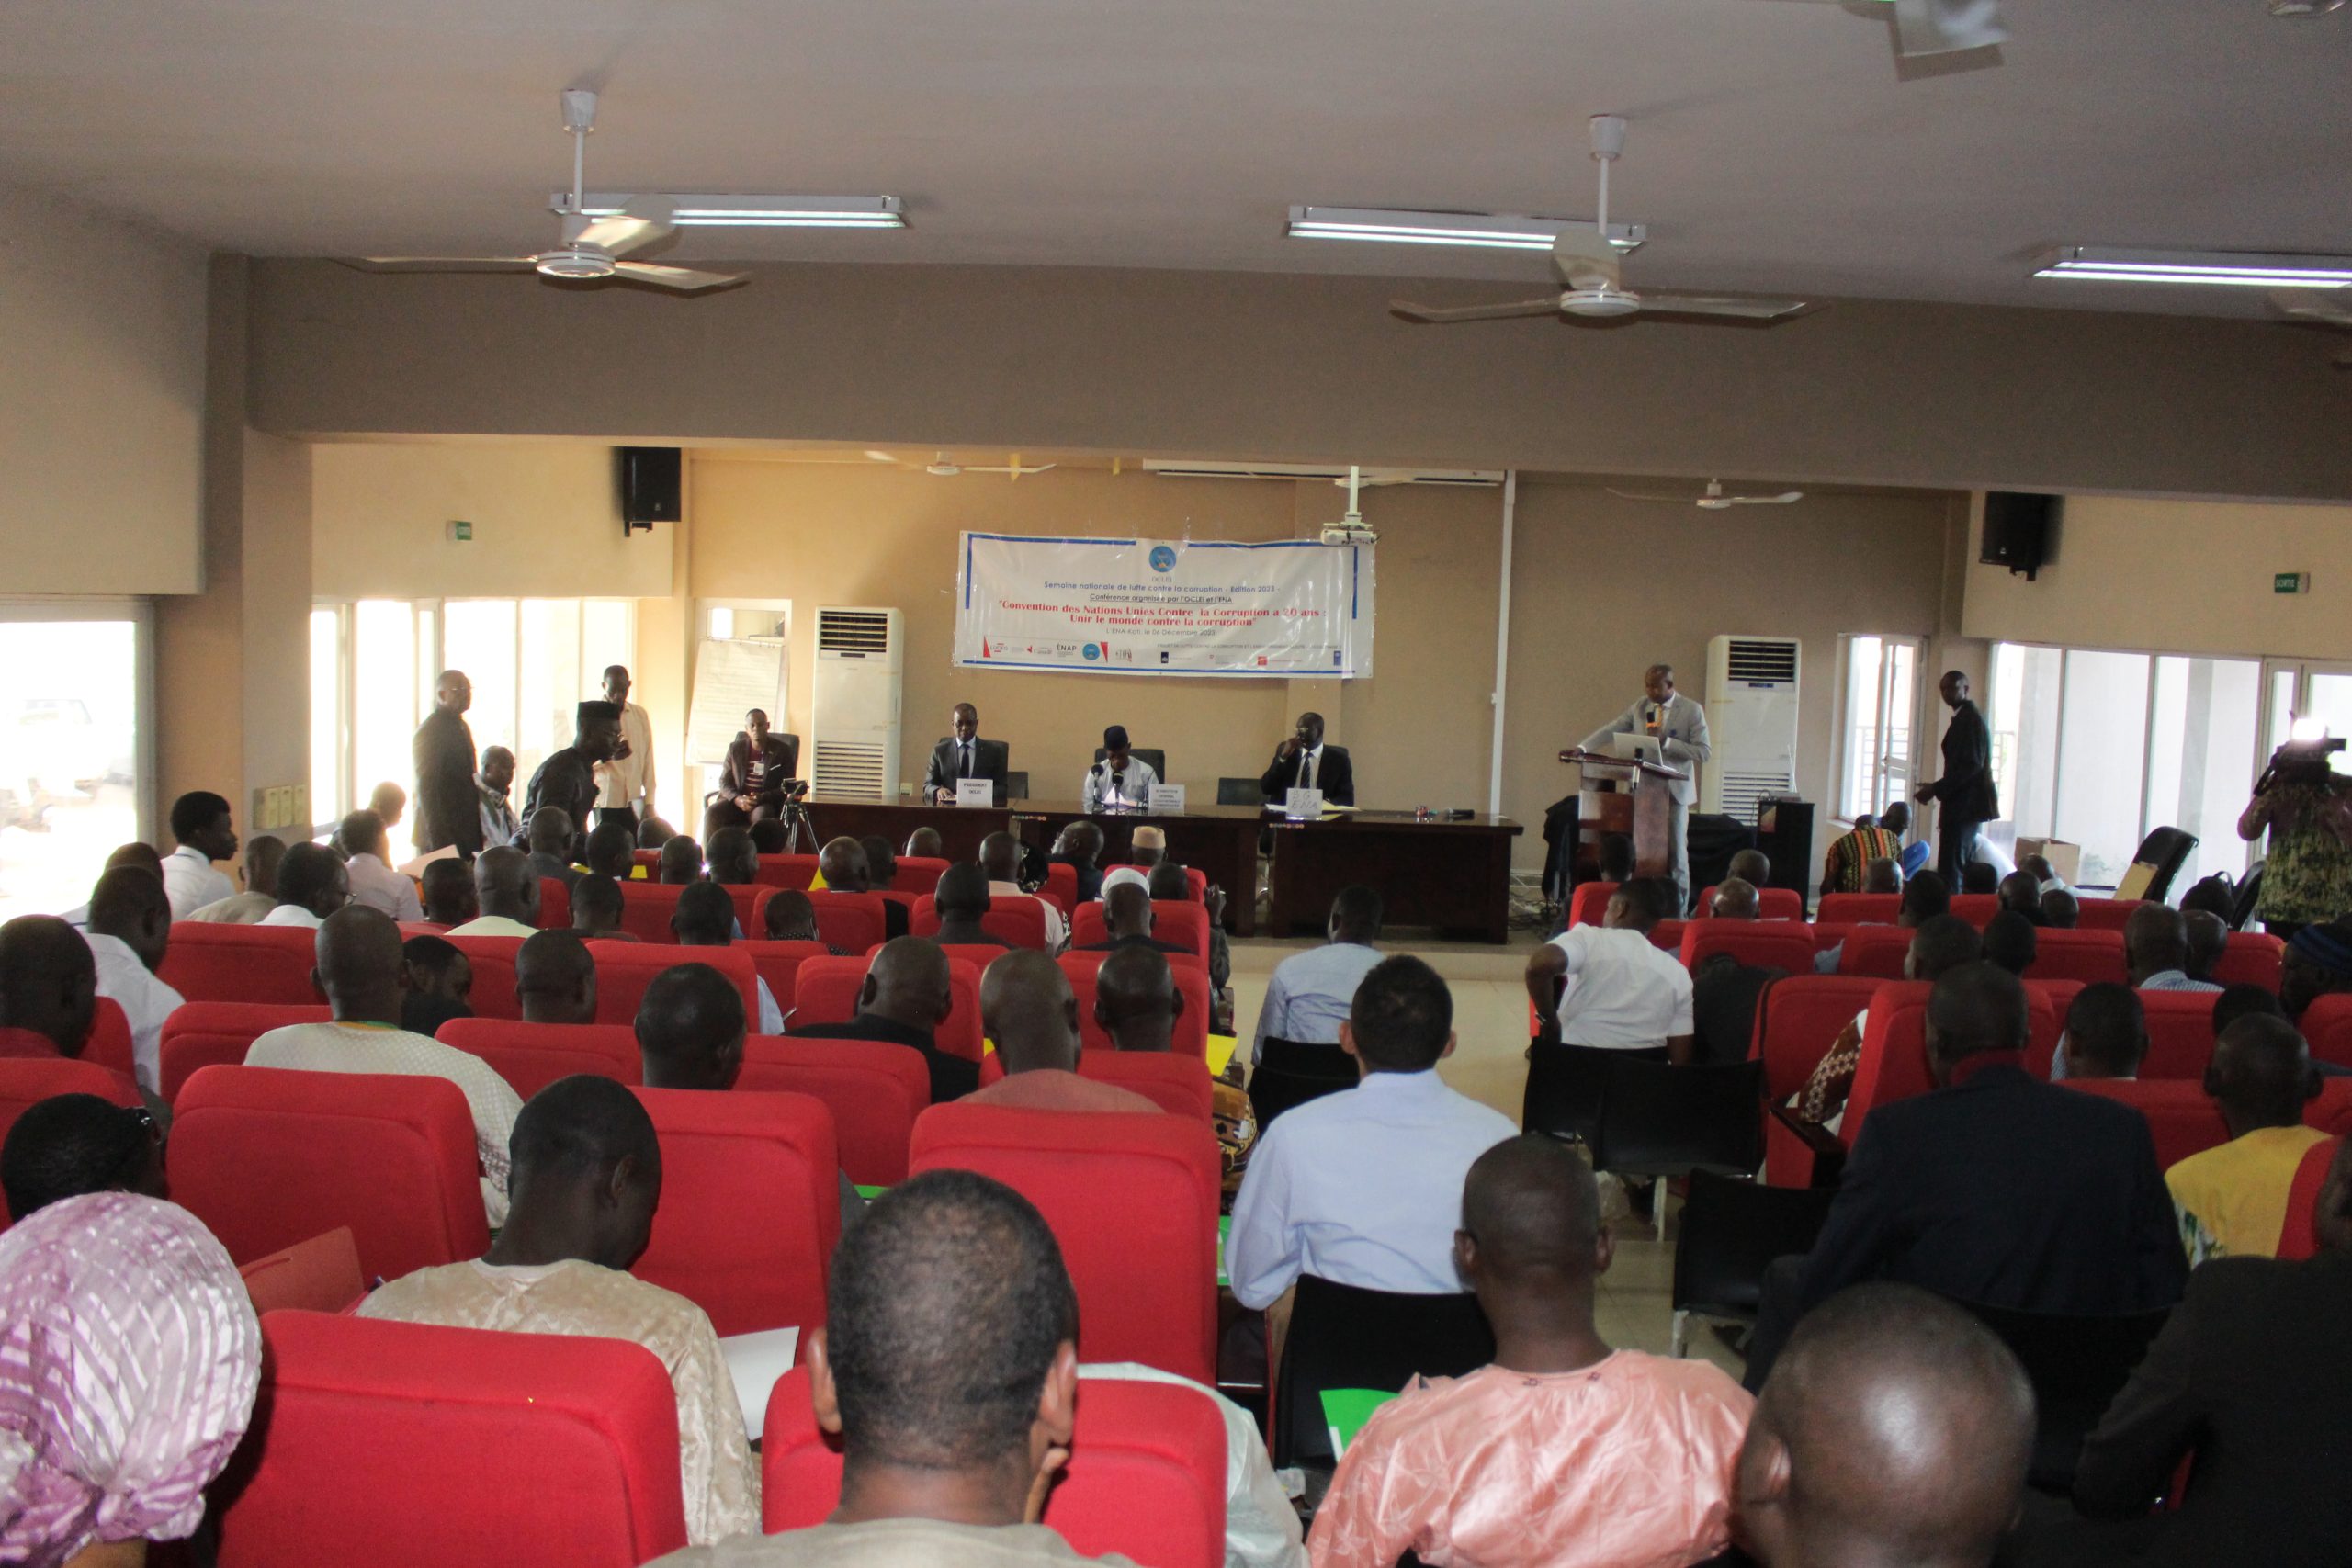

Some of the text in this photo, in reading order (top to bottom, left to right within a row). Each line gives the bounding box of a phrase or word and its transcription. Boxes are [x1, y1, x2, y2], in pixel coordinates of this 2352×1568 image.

[1062, 604, 1080, 613] des
[1084, 606, 1123, 615] Nations
[1126, 606, 1155, 615] Unies
[1159, 608, 1193, 616] Contre
[1213, 609, 1269, 619] Corruption
[1283, 609, 1297, 617] 20
[1070, 615, 1092, 623] Unir
